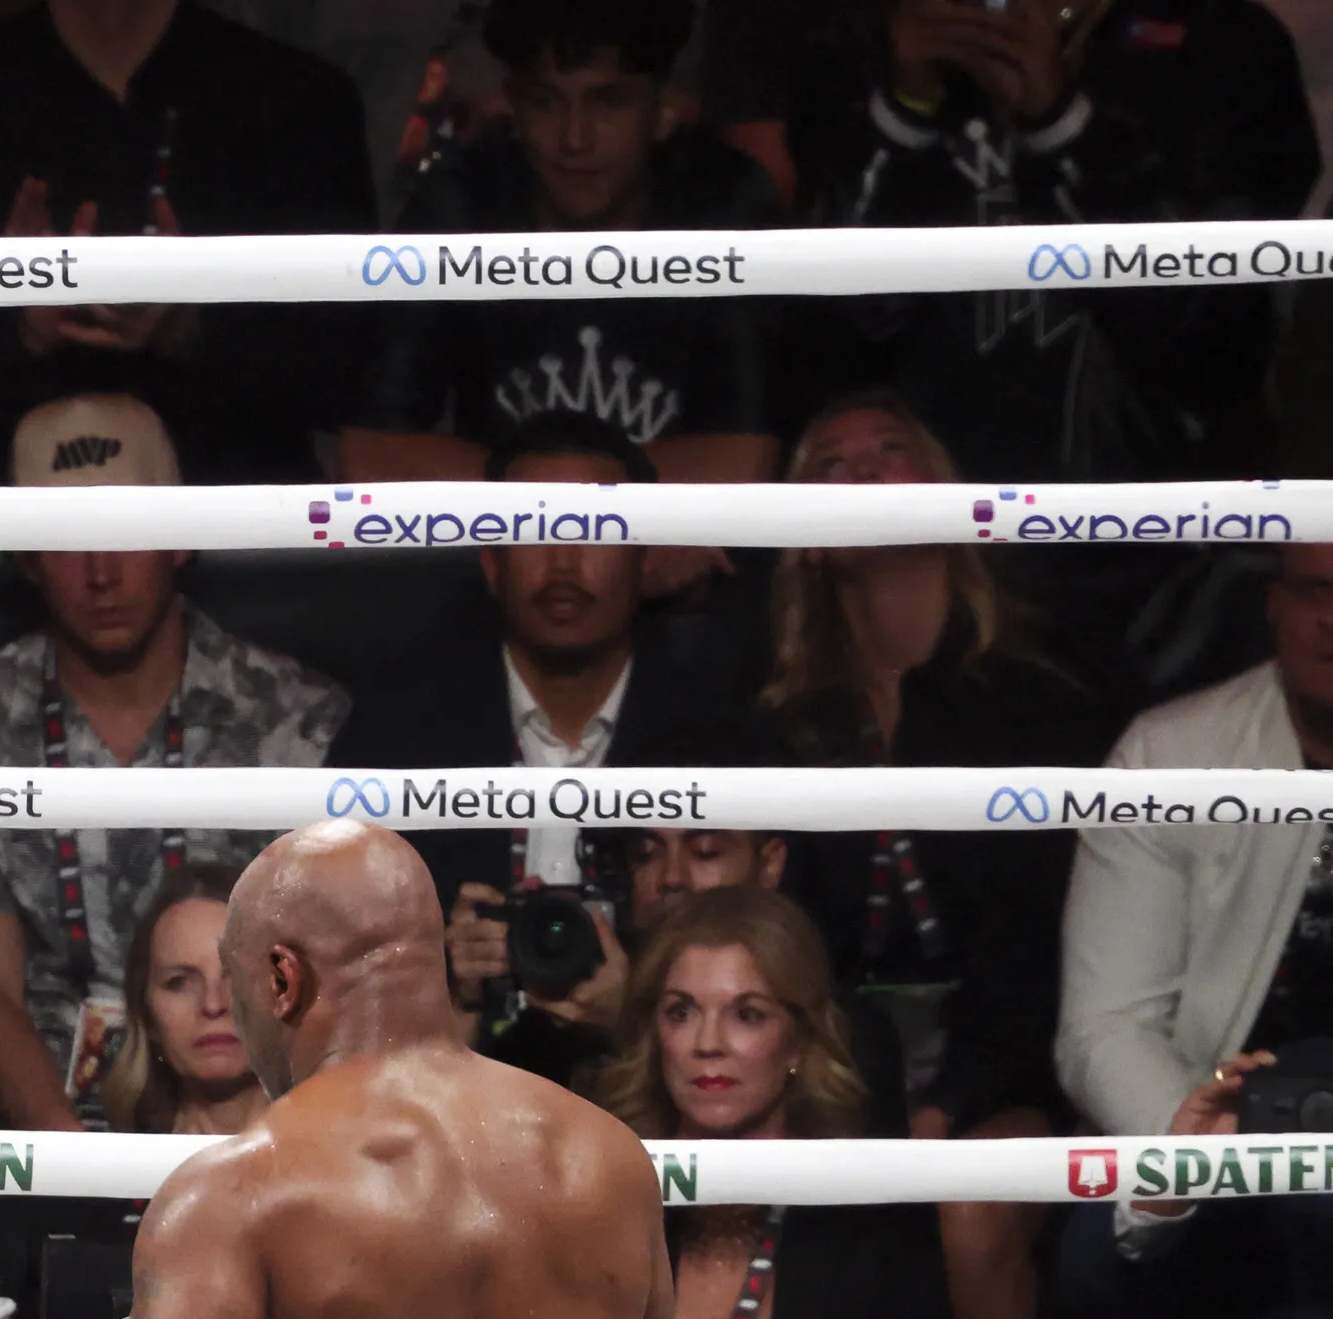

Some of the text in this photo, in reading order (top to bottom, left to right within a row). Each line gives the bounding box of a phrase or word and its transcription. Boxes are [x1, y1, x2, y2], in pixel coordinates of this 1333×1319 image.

[439, 245, 745, 289] Meta Quest
[1104, 244, 1237, 279] Meta
[354, 501, 628, 543] experian
[403, 779, 706, 822] Meta Quest
[1062, 790, 1333, 823] Meta Que
[1132, 1145, 1333, 1196] SPATE
